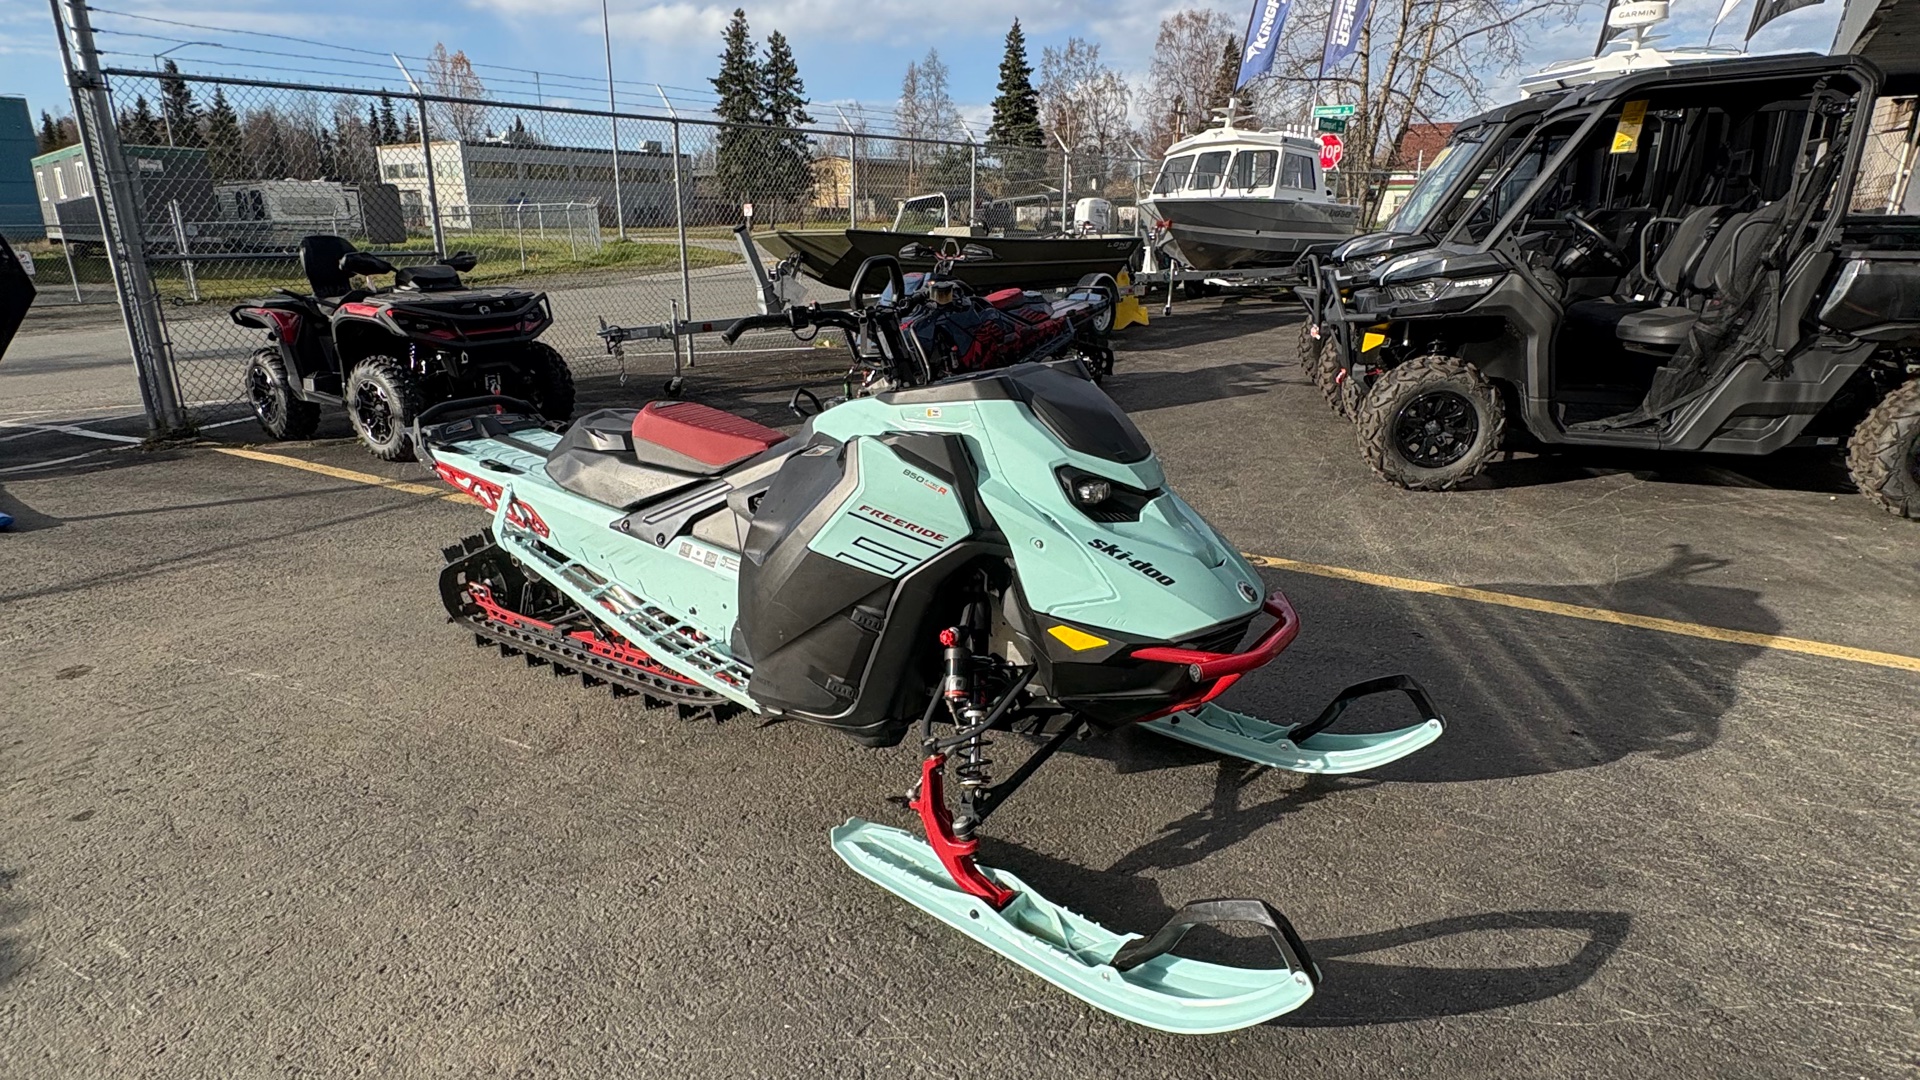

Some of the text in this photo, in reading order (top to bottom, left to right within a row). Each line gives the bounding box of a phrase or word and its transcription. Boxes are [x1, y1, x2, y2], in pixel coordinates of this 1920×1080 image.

[1619, 9, 1657, 18] GARMIN
[1319, 144, 1341, 159] TOP
[902, 465, 925, 483] 850
[937, 486, 948, 496] R
[858, 504, 949, 542] FREERIDE
